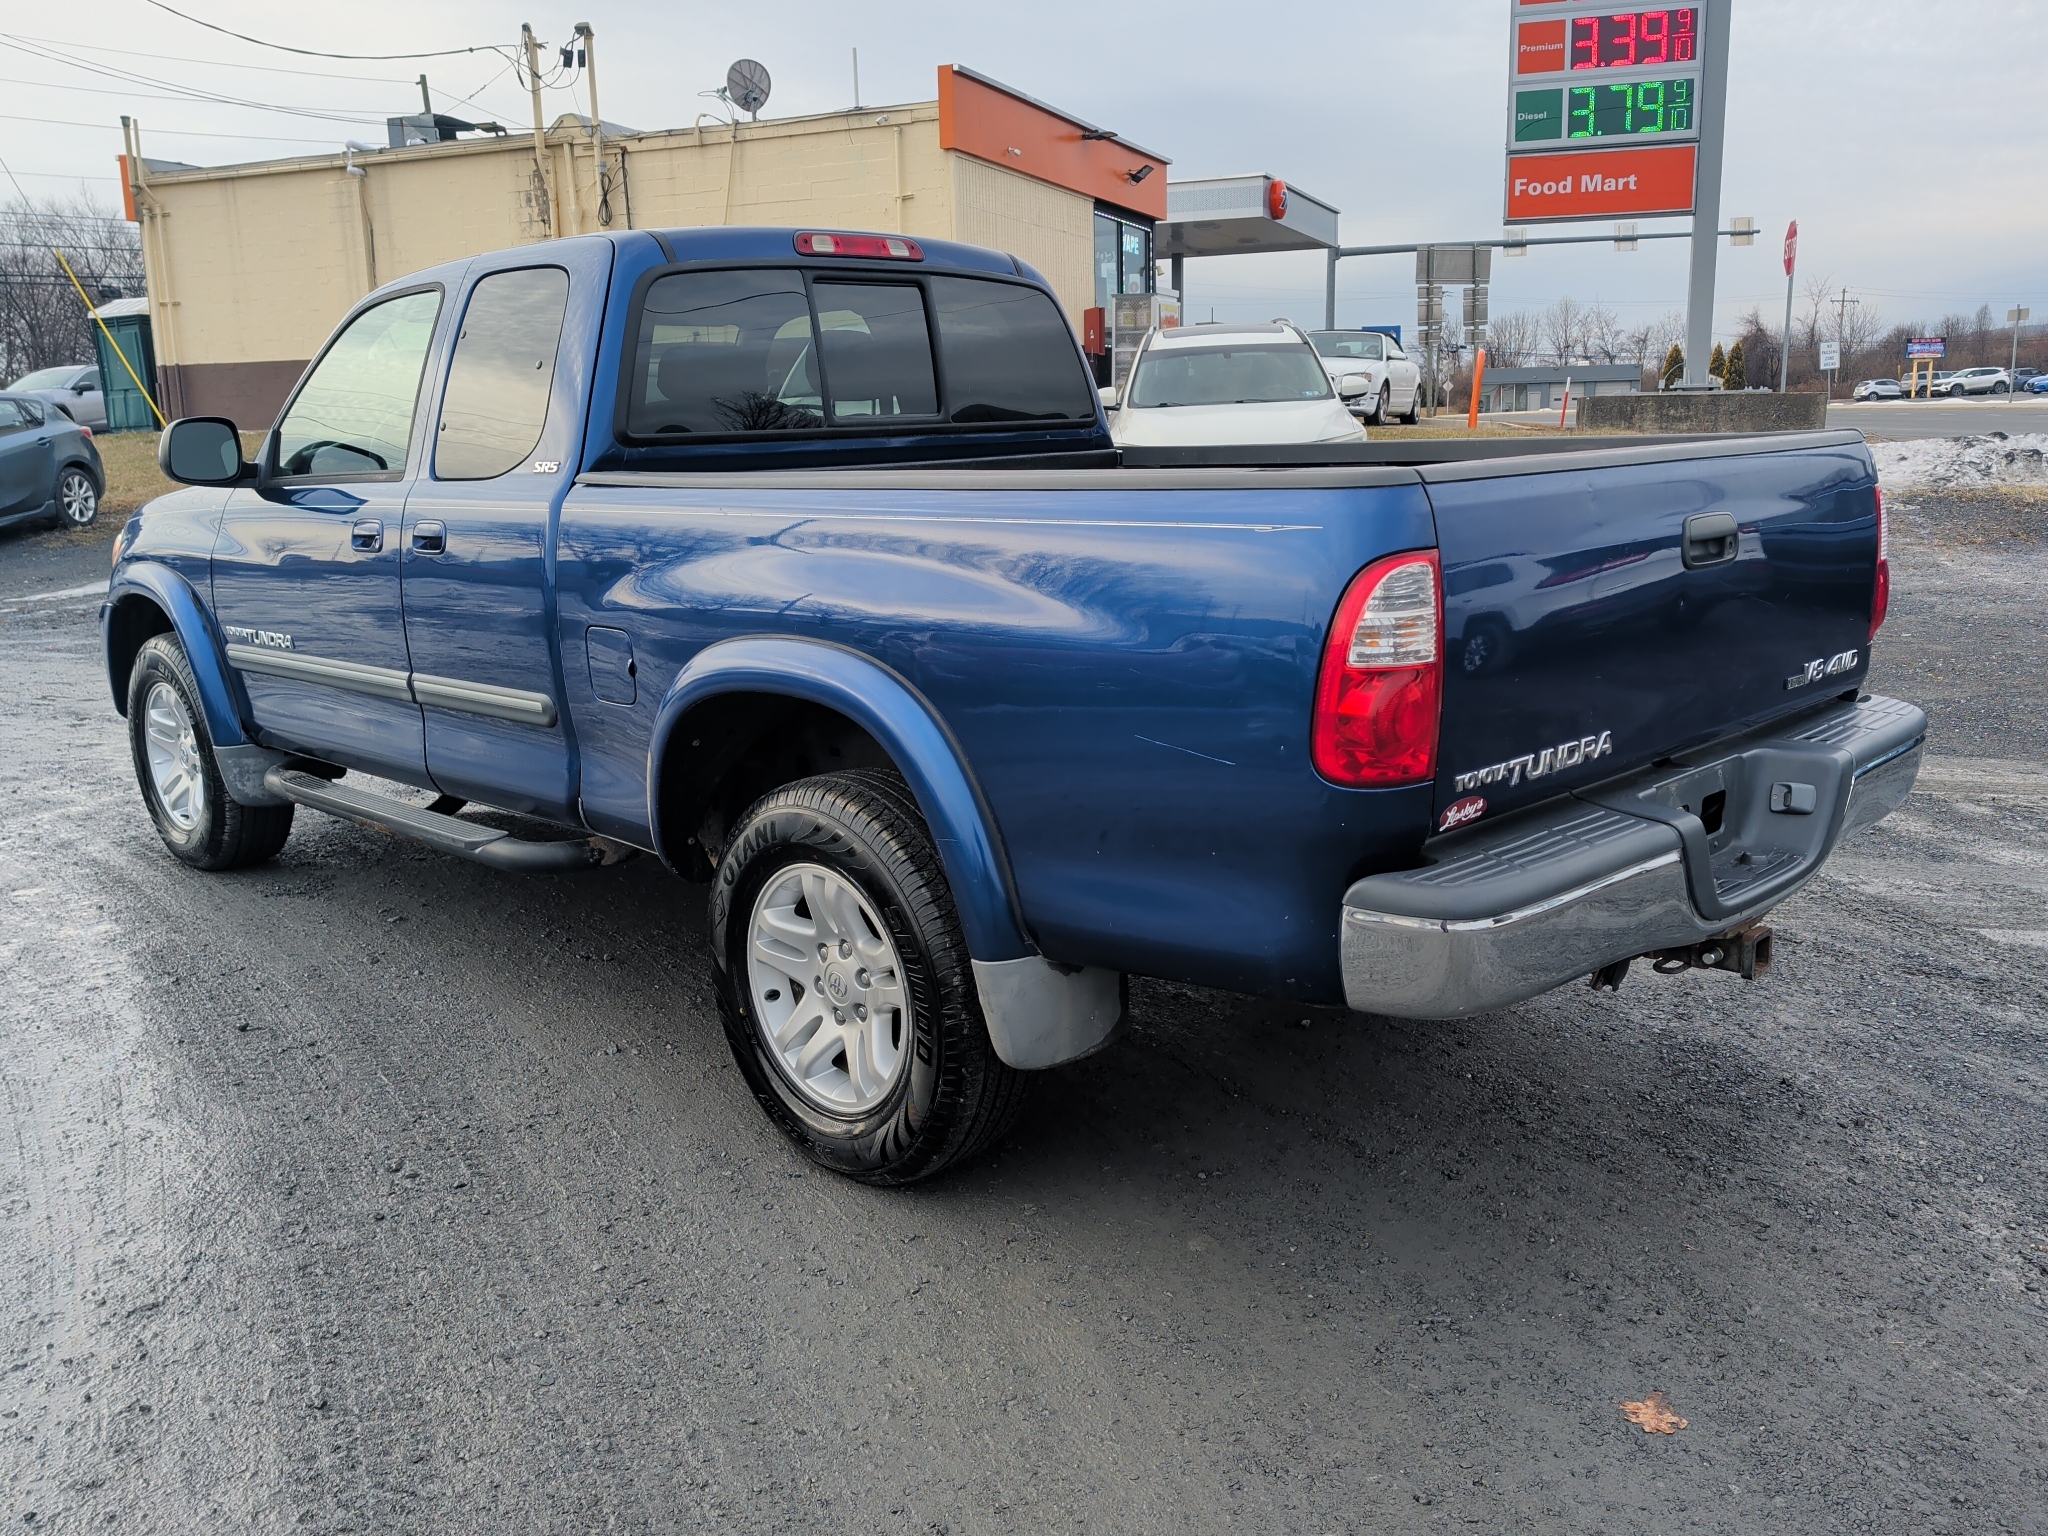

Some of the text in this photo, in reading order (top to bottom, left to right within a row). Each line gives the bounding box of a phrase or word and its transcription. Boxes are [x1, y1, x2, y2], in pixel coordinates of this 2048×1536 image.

[1520, 11, 1669, 70] Premium 3.39
[1517, 81, 1665, 139] Diesel 3.79
[1514, 173, 1638, 197] Food Mart
[1123, 233, 1139, 255] VAPE
[1784, 236, 1797, 260] STOP
[533, 461, 560, 473] SR5
[245, 628, 292, 650] TUNDRA
[1802, 658, 1825, 685] V8
[1824, 649, 1858, 677] 4WD
[1453, 730, 1613, 793] TOYOTA TUNDRA
[722, 820, 778, 887] OTANI
